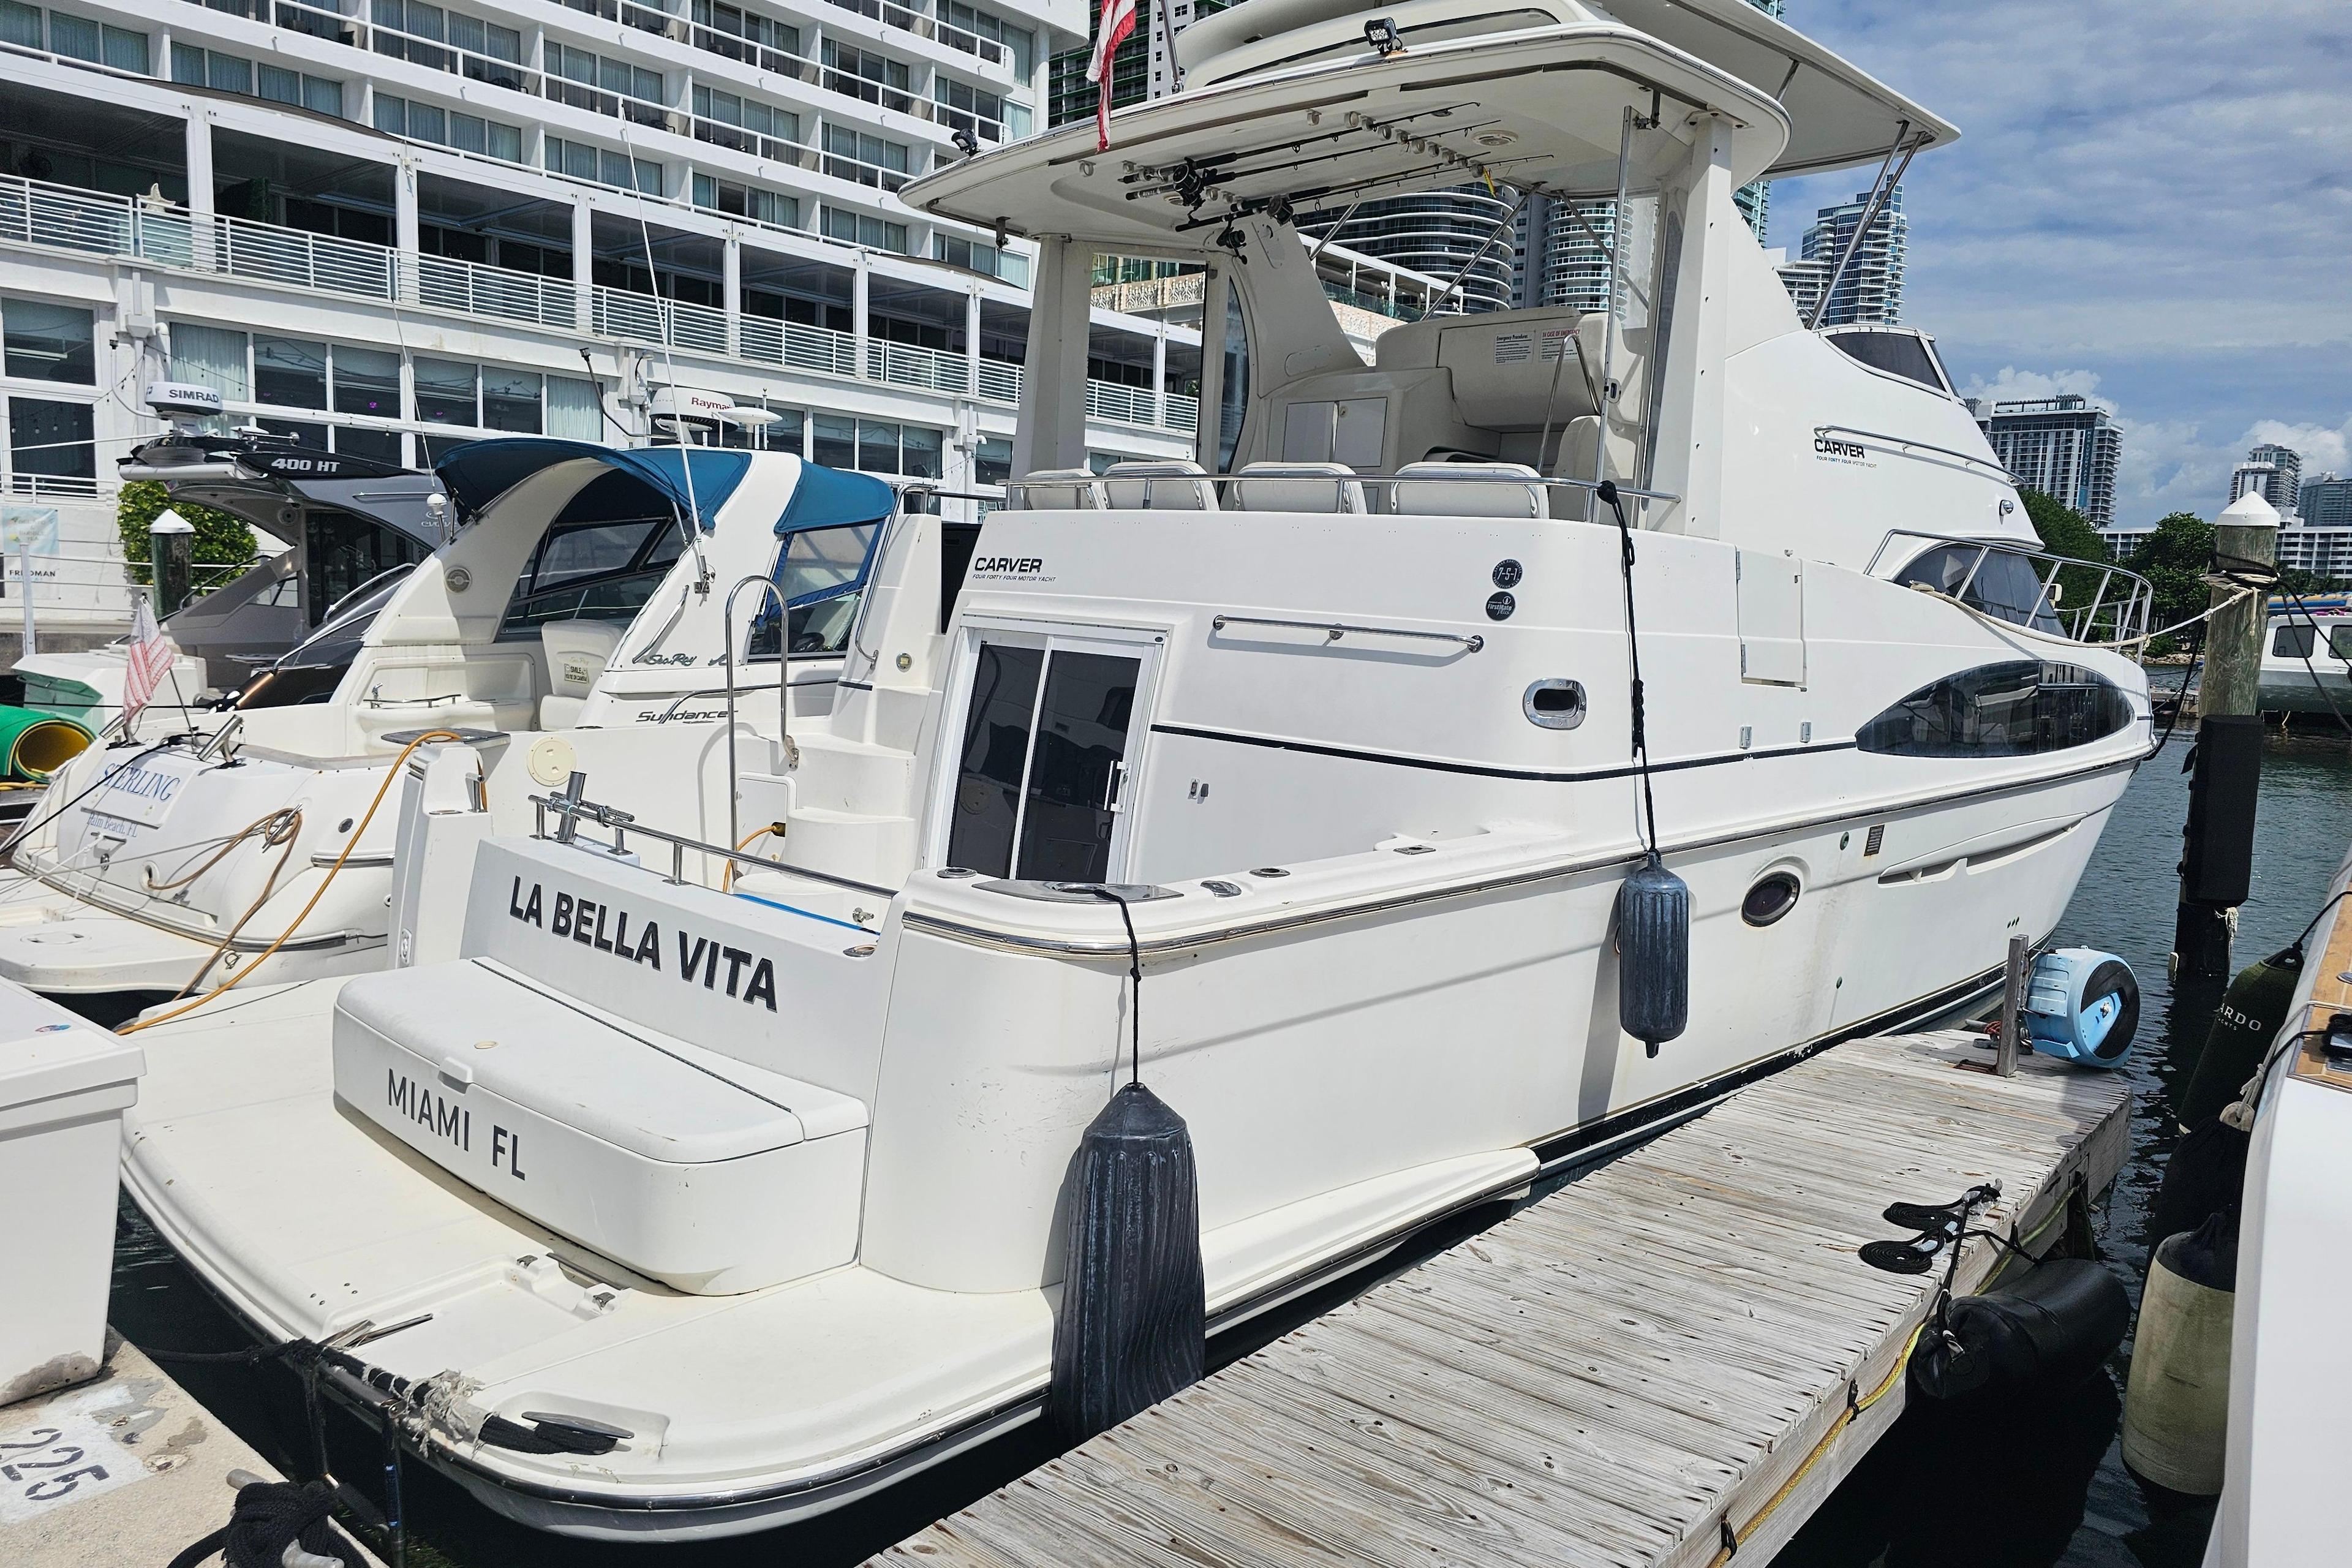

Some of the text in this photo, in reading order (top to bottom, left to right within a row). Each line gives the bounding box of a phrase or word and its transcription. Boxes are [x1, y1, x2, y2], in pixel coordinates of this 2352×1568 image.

[169, 390, 219, 403] SIMRAD
[1814, 439, 1864, 458] CARVER
[271, 458, 340, 472] 400 HT
[974, 557, 1042, 573] CARVER
[1497, 567, 1517, 581] 7-5-1
[96, 763, 181, 802] STERLING
[87, 813, 104, 827] Palm
[127, 824, 138, 837] FL
[510, 875, 777, 1013] LA BELLA VITA
[388, 1068, 526, 1181] MIAMI FL
[0, 1428, 110, 1501] 225
